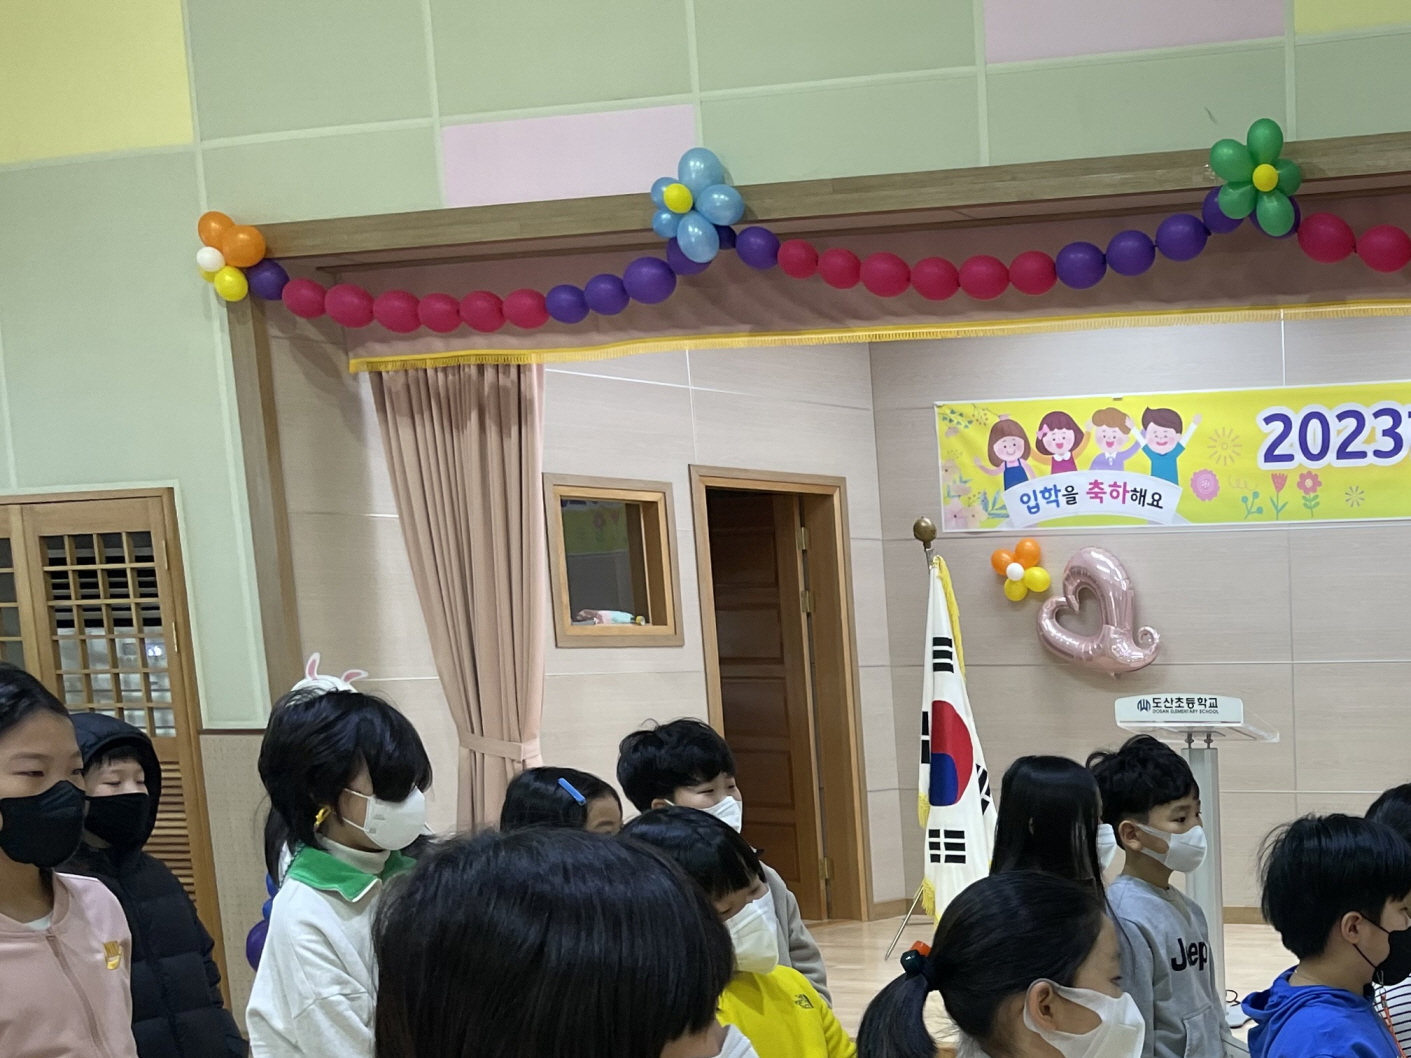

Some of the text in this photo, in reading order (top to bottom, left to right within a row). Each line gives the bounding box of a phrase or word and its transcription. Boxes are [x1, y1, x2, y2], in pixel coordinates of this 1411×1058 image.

[1019, 479, 1164, 515] 입학을 축하해요
[1152, 697, 1219, 710] 도산초등학교
